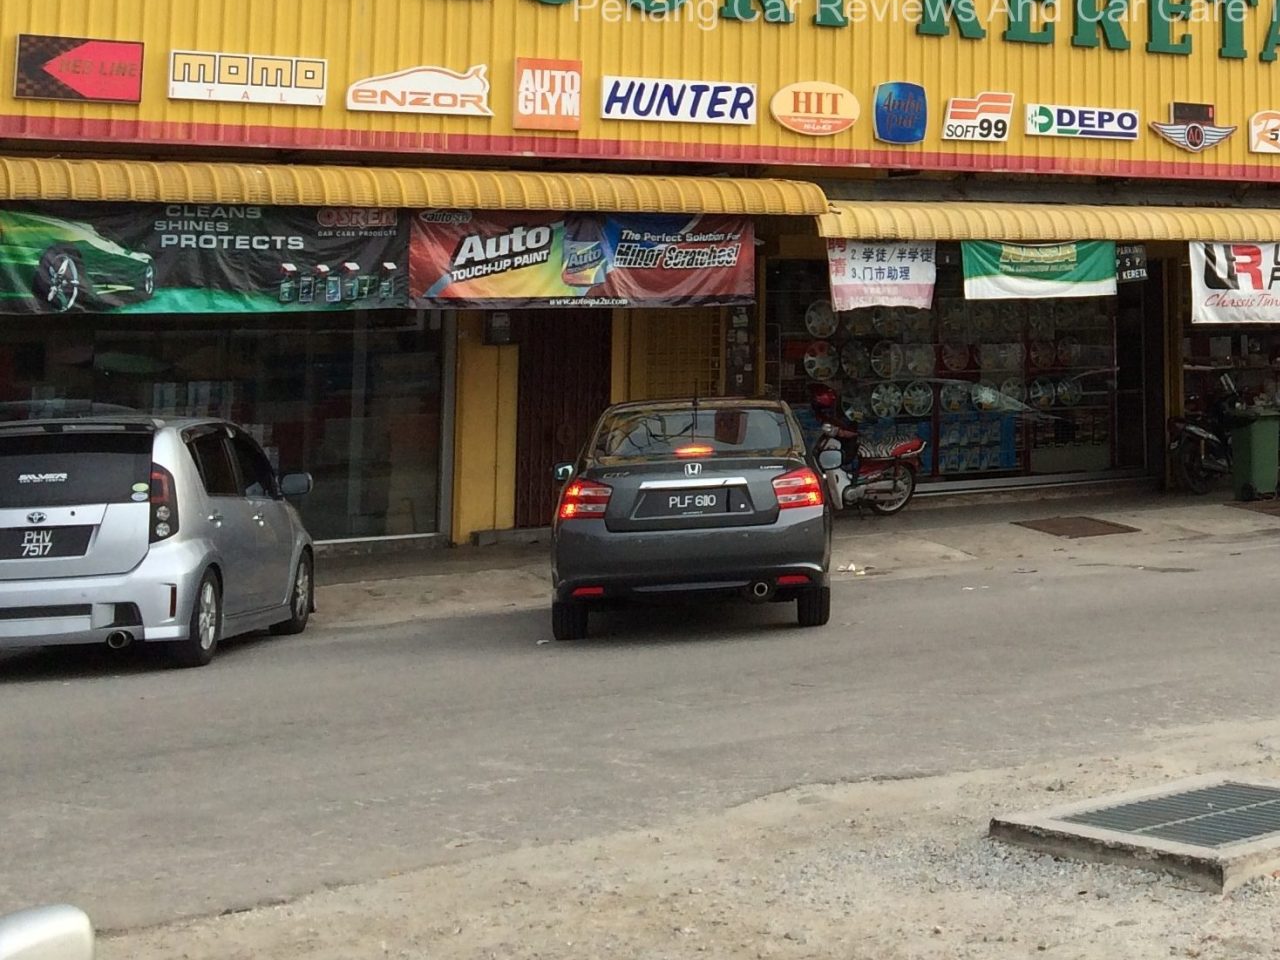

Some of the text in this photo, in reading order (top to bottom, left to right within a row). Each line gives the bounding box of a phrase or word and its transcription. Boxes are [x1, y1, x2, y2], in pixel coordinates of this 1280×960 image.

[518, 68, 581, 93] AUTO
[171, 88, 323, 104] ITALY
[518, 91, 580, 117] GLYM
[604, 80, 755, 120] HUNTER
[792, 91, 844, 116] HIT
[1056, 108, 1138, 131] DEPO
[165, 205, 262, 220] CLEANS
[154, 220, 229, 232] SHINES
[160, 234, 304, 251] PROTECTS
[621, 229, 641, 241] The
[644, 232, 682, 242] Perfect
[685, 232, 724, 242] Solution
[453, 226, 551, 267] Auto
[451, 250, 550, 282] TOUCH-UP PAINT
[1204, 290, 1256, 308] Chassis
[669, 496, 693, 509] PLF
[24, 530, 53, 543] PHV
[21, 543, 53, 557] 7517
